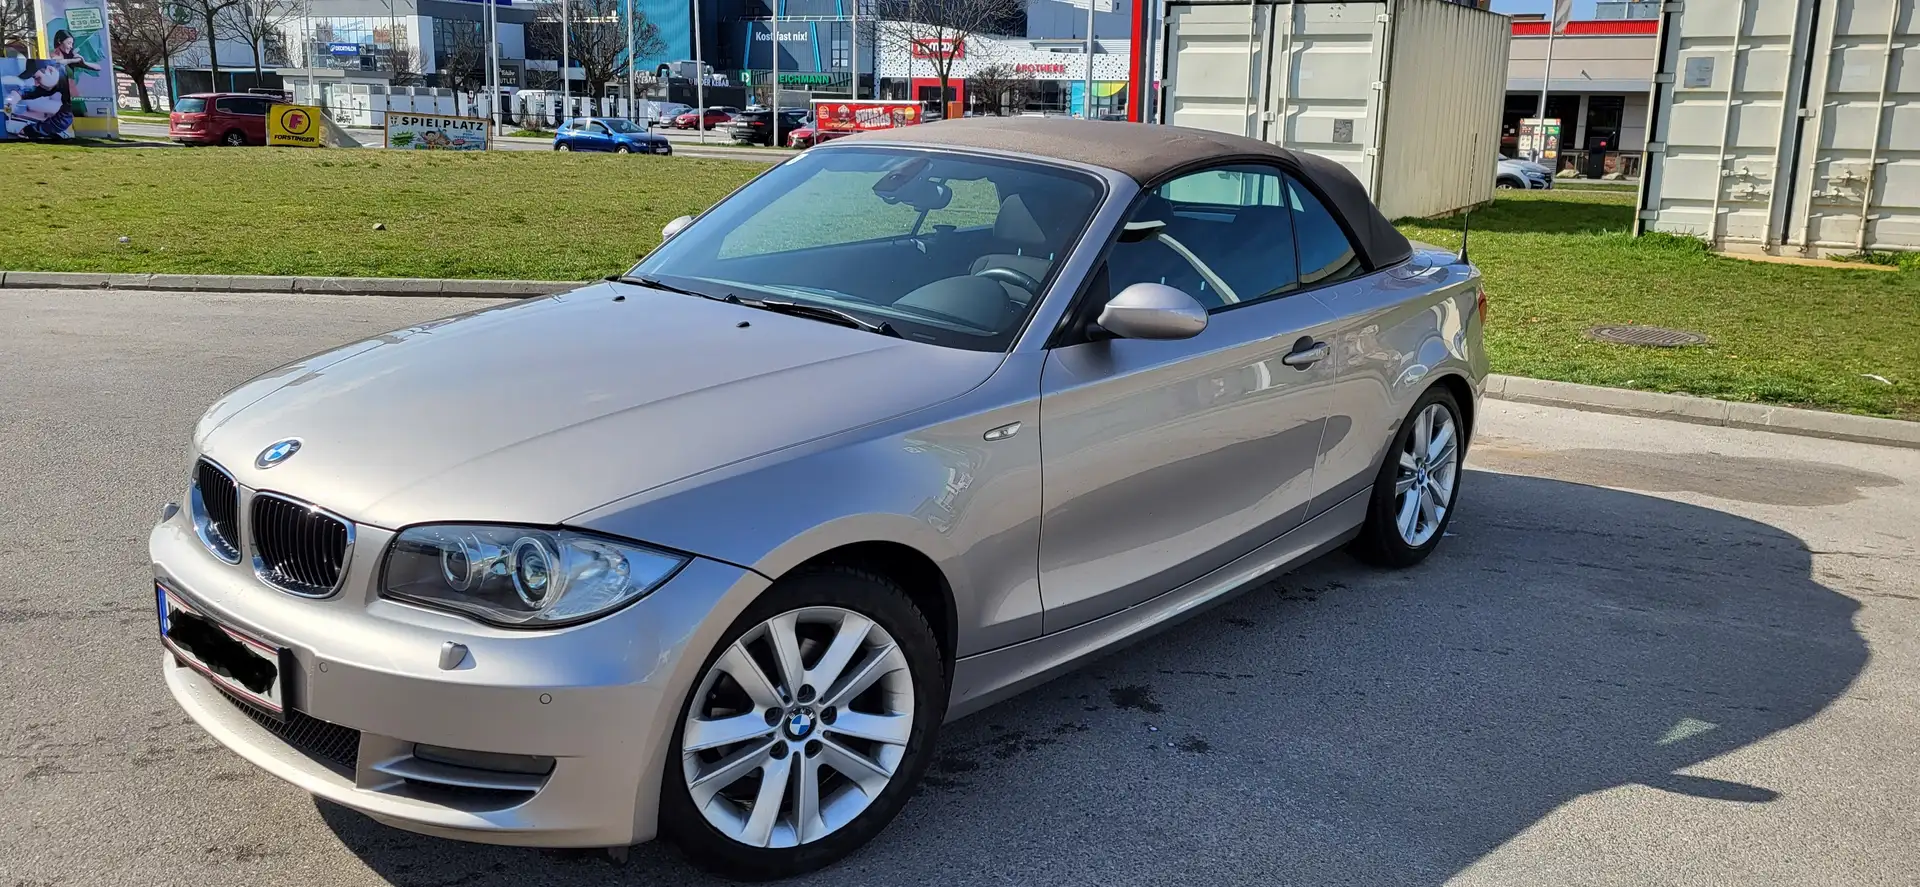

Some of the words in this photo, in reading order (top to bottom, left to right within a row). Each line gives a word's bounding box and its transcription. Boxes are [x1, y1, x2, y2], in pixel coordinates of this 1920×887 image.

[776, 31, 792, 41] fast
[792, 31, 808, 41] nix!
[1015, 63, 1065, 73] APOTHEKE
[778, 74, 829, 84] EICHMANN
[855, 106, 885, 124] SWEET
[289, 113, 304, 129] F
[401, 116, 484, 131] SPIELPLATZ
[274, 134, 315, 143] FORSTINGER
